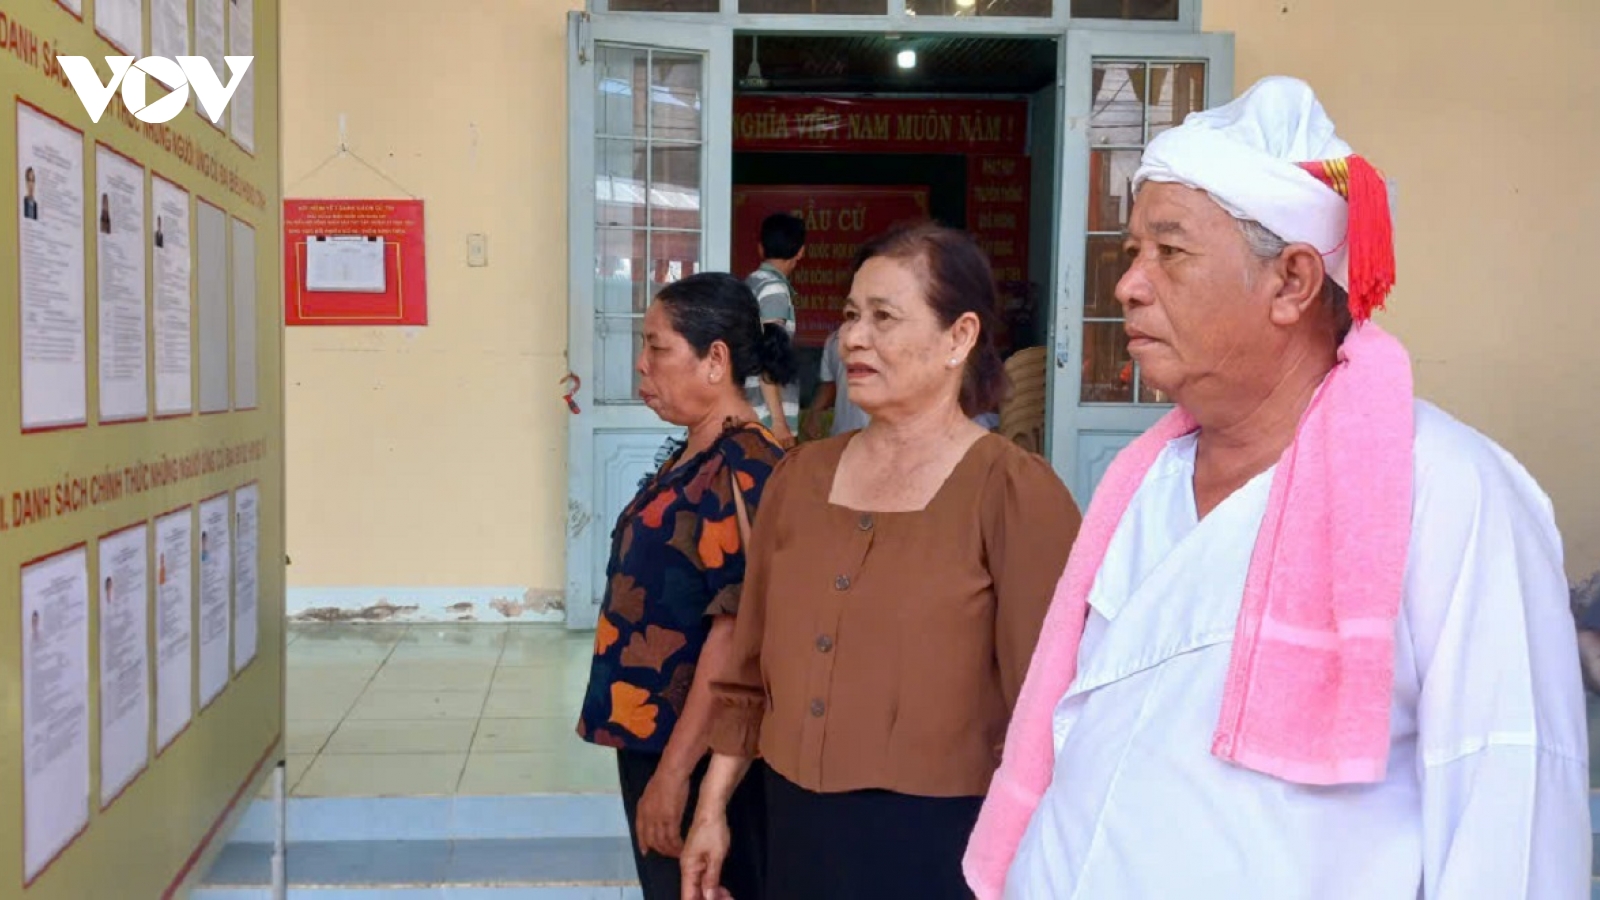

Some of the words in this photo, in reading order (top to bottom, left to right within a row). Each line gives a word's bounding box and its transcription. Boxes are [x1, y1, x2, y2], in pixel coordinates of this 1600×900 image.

[847, 113, 889, 140] NAM
[897, 107, 953, 140] MUÔN
[12, 486, 51, 528] DANH
[55, 472, 88, 517] SÁCH
